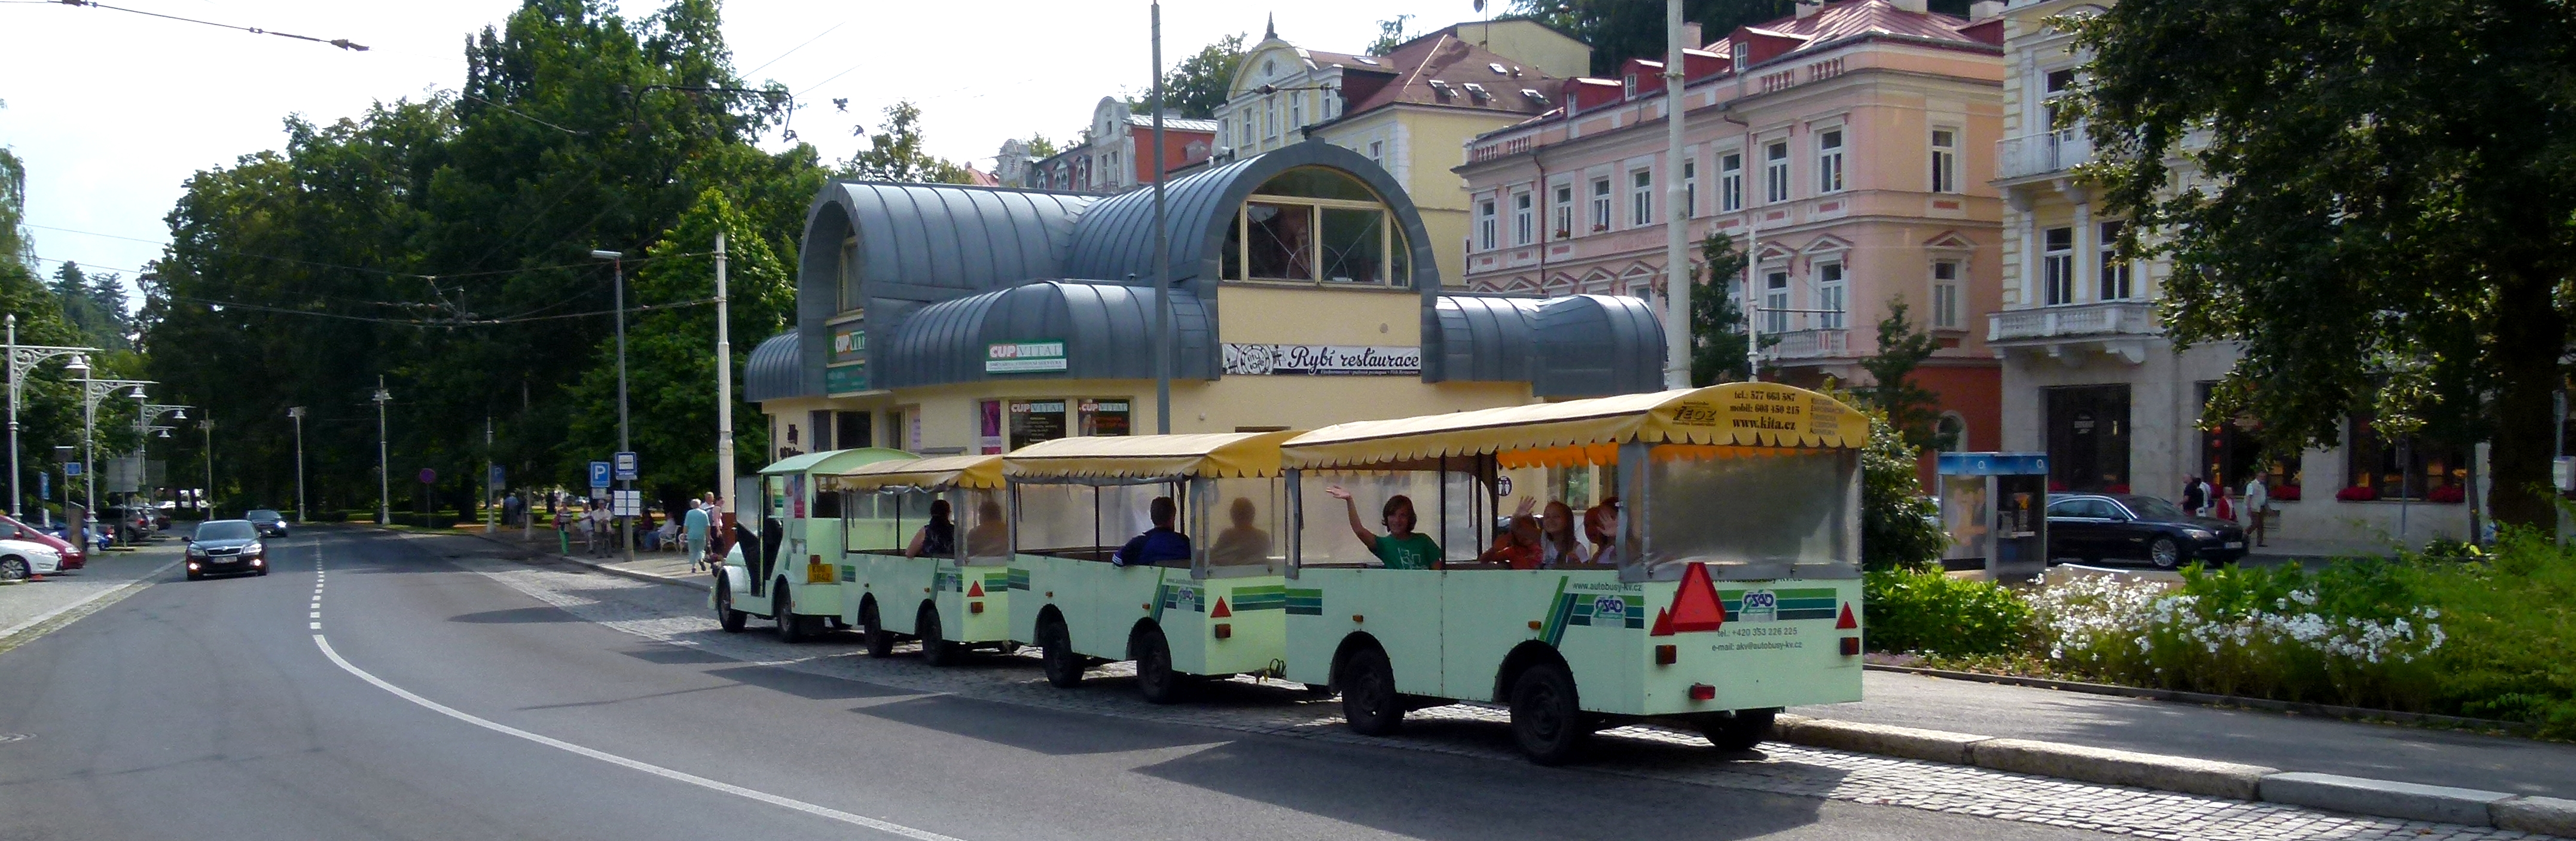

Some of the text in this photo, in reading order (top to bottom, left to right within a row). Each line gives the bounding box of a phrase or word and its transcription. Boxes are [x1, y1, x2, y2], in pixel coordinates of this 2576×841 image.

[990, 345, 1063, 358] CUP VITAL
[1287, 346, 1419, 374] Rybí restaurace
[1735, 391, 1748, 400] tel.:
[1751, 391, 1764, 400] 577
[1783, 392, 1795, 401] 587
[1011, 403, 1064, 412] CUP VITAL
[1730, 403, 1753, 412] mobil:
[1771, 405, 1784, 414] 450
[1786, 406, 1800, 415] 215
[1733, 416, 1796, 431] www.kita.cz
[594, 465, 606, 479] P
[1573, 583, 1642, 592] www.autobusy-kv.cz
[1712, 641, 1802, 651] e-mail: akv@autobusy-kv.cz
